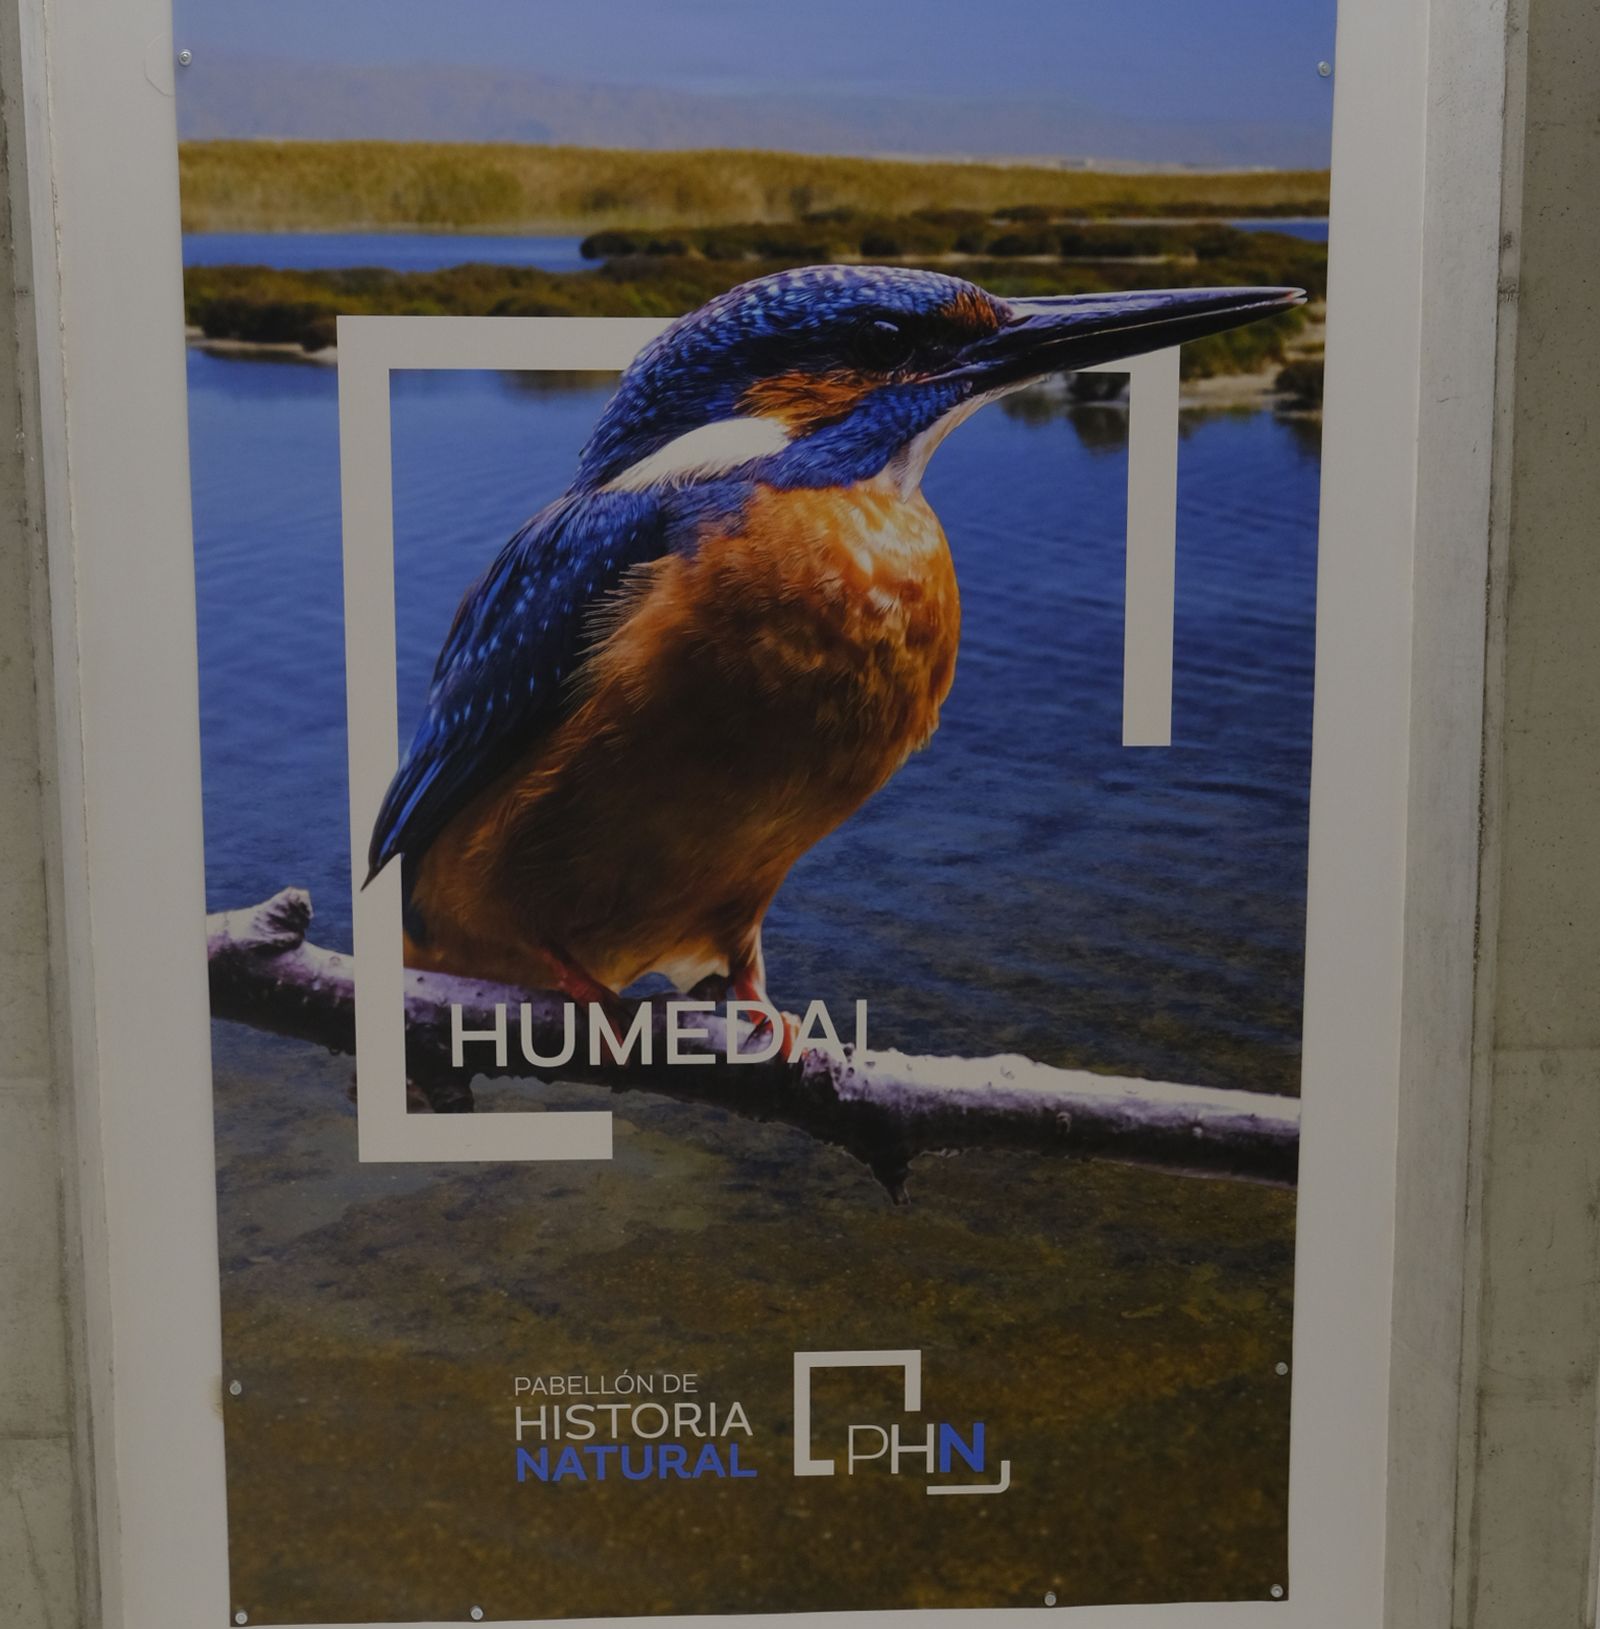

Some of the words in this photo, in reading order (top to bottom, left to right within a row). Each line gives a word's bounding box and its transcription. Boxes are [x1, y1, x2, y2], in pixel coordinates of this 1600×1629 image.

[514, 1369, 654, 1396] PABELLÓN
[664, 1374, 698, 1393] DE
[515, 1402, 754, 1440] HISTORIA
[516, 1443, 758, 1482] NATURAL
[848, 1423, 985, 1475] PHN
